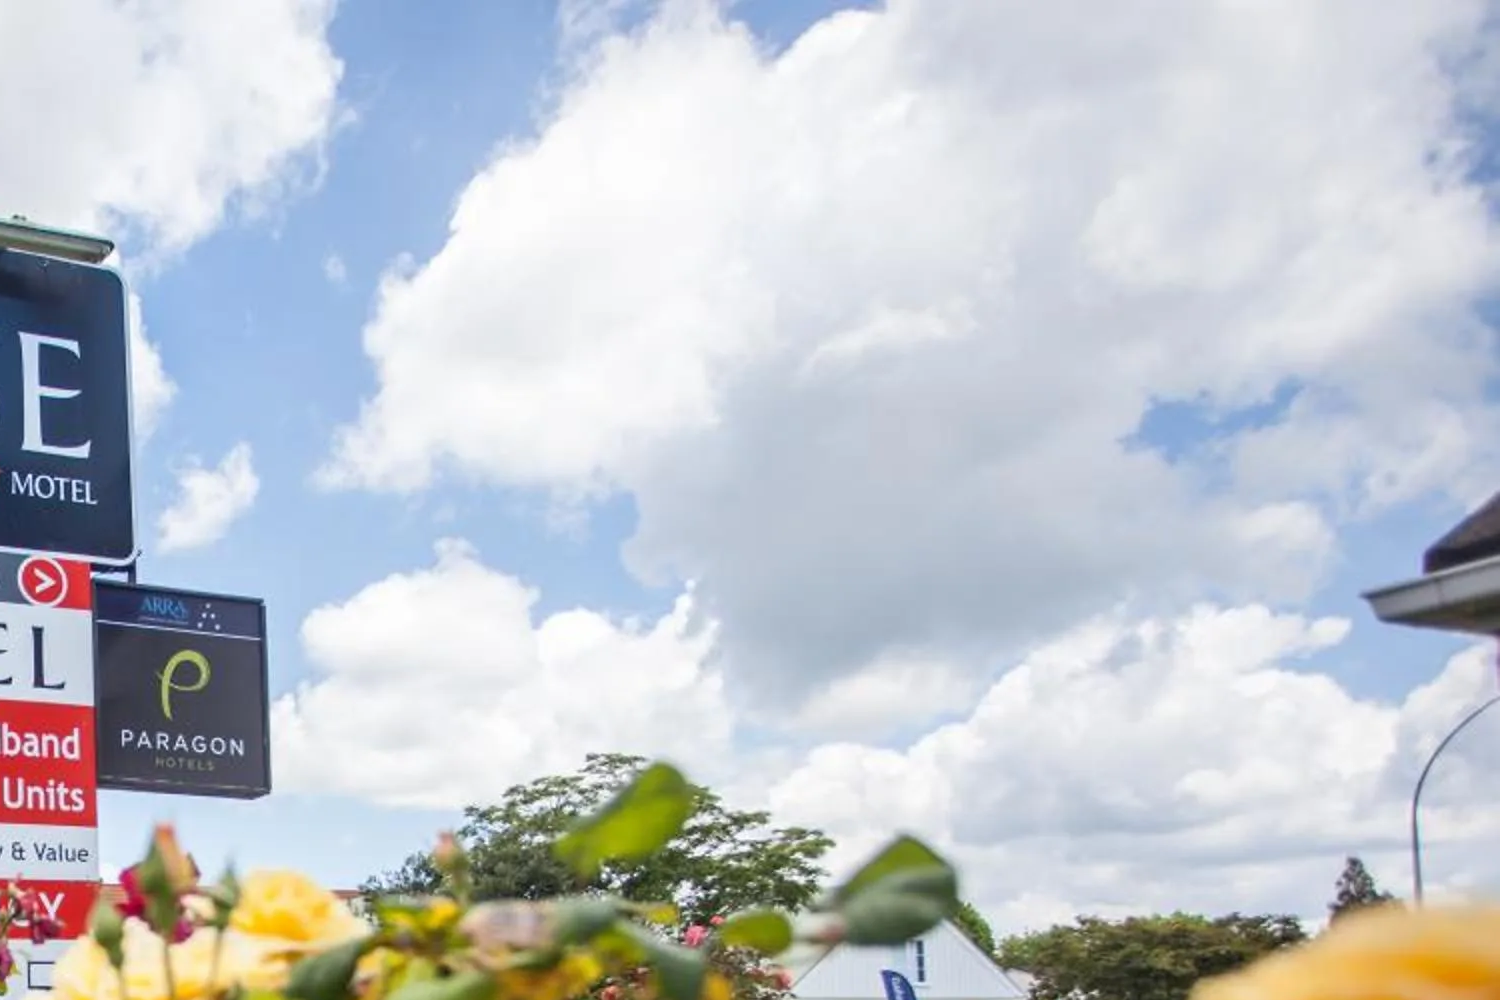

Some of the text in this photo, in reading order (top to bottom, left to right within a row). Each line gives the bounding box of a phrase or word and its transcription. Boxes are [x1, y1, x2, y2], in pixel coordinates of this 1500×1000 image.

[11, 471, 98, 505] MOTEL
[121, 729, 245, 756] PARAGON
[155, 757, 215, 772] HOTELS
[2, 777, 85, 812] Units
[11, 842, 26, 861] &
[33, 843, 89, 863] Value
